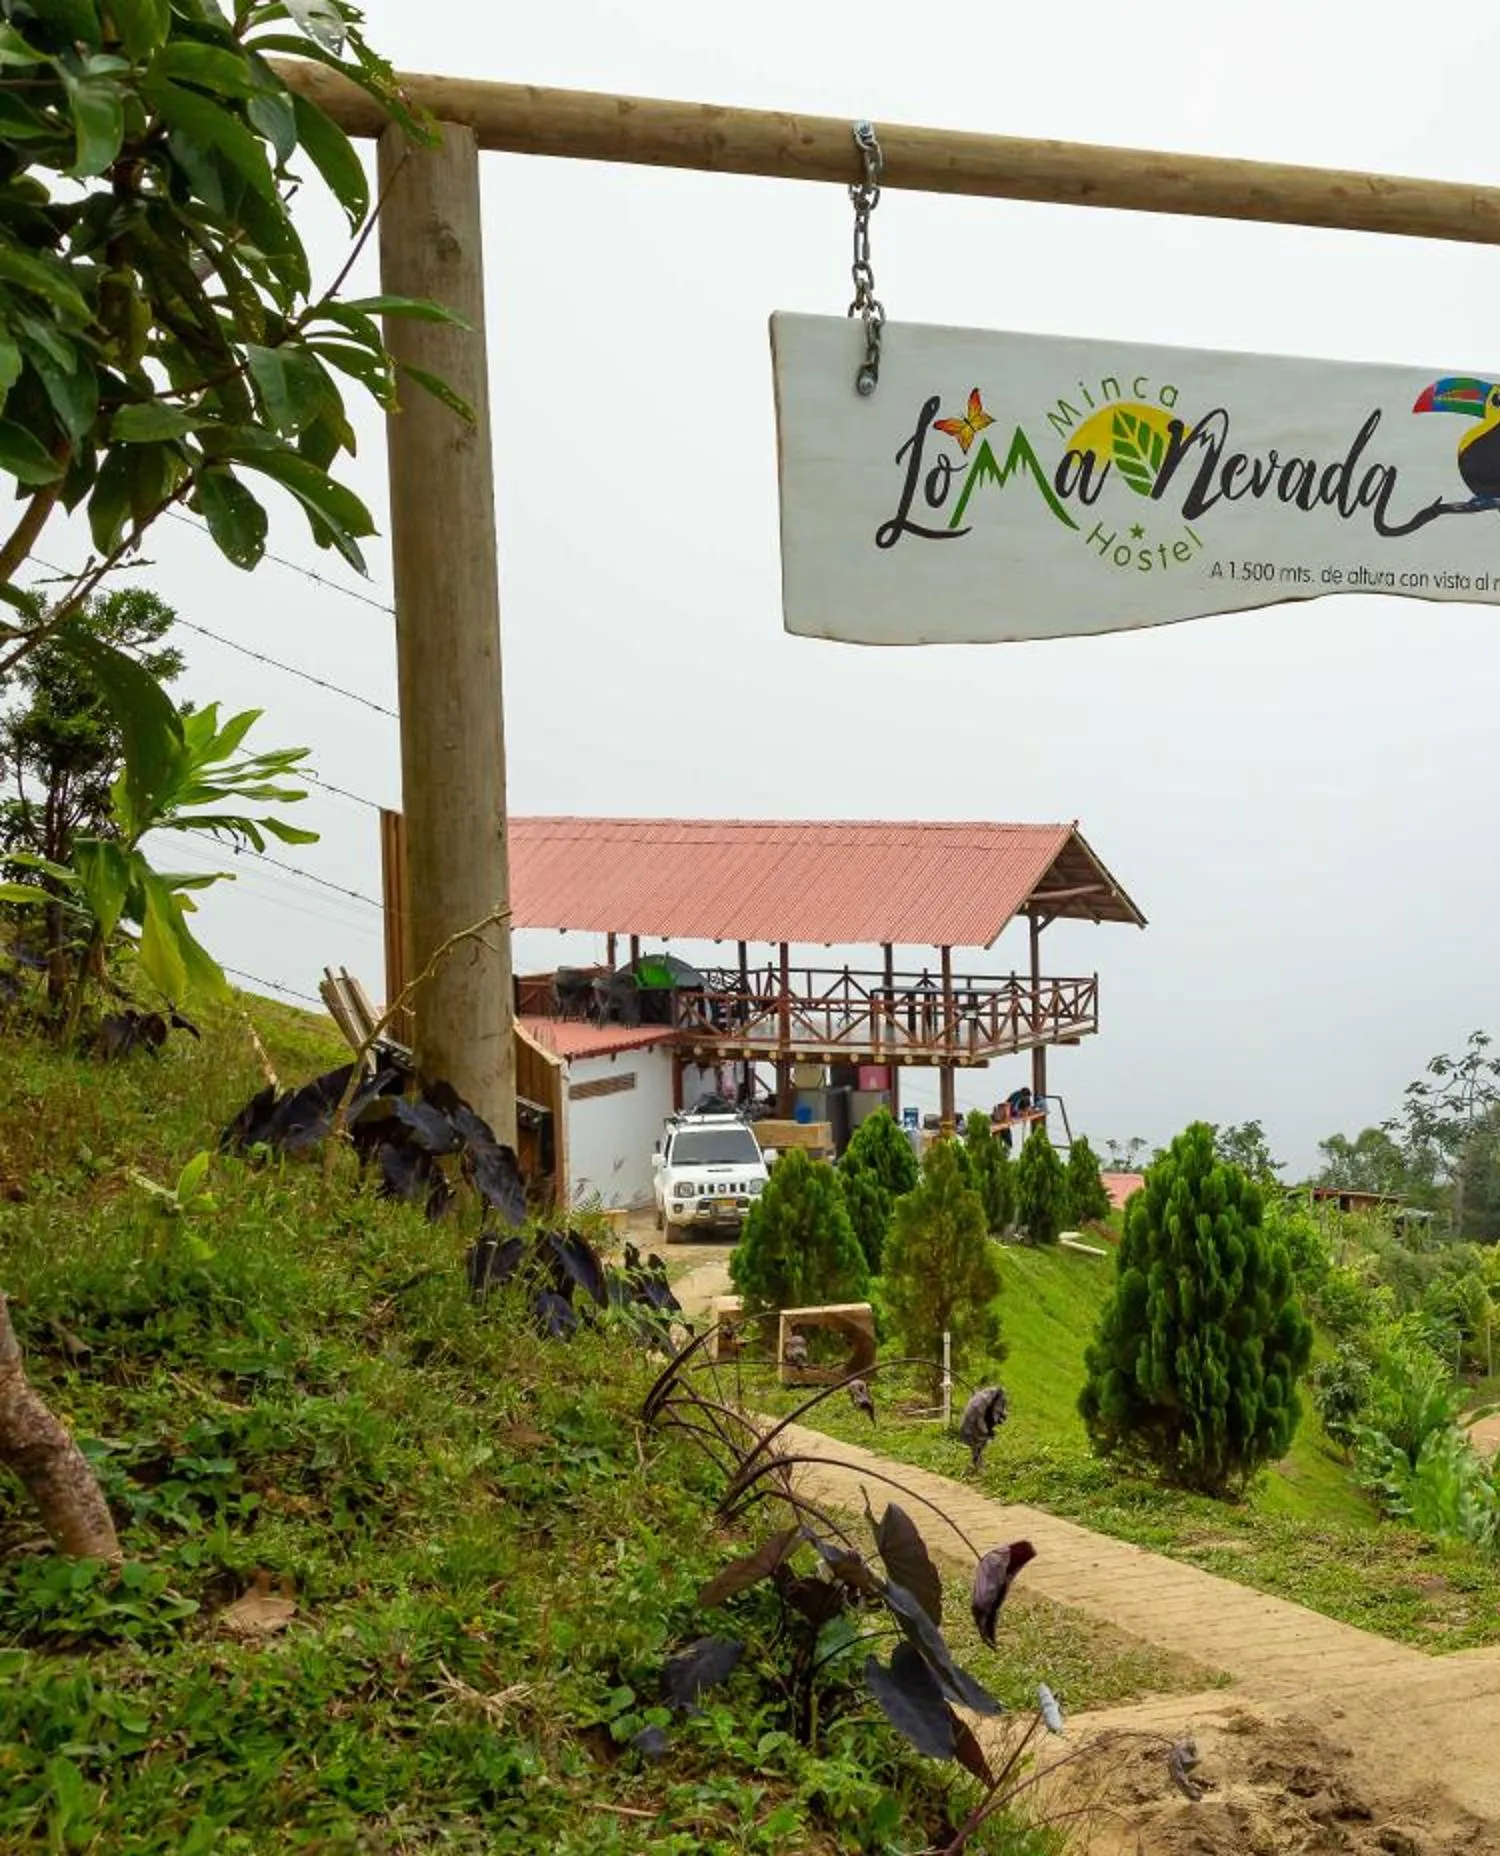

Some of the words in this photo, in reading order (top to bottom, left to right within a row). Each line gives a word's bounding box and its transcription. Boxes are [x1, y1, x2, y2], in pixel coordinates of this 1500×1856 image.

[1046, 375, 1179, 438] Minca
[1085, 521, 1204, 572] Hostel
[1210, 561, 1223, 579] A
[1229, 561, 1275, 582] 1.500
[1280, 565, 1315, 584] mts.
[1321, 566, 1343, 584] de
[1347, 565, 1395, 587] altura
[1400, 572, 1429, 588] con
[1433, 571, 1471, 590] vista
[1475, 572, 1489, 591] al
